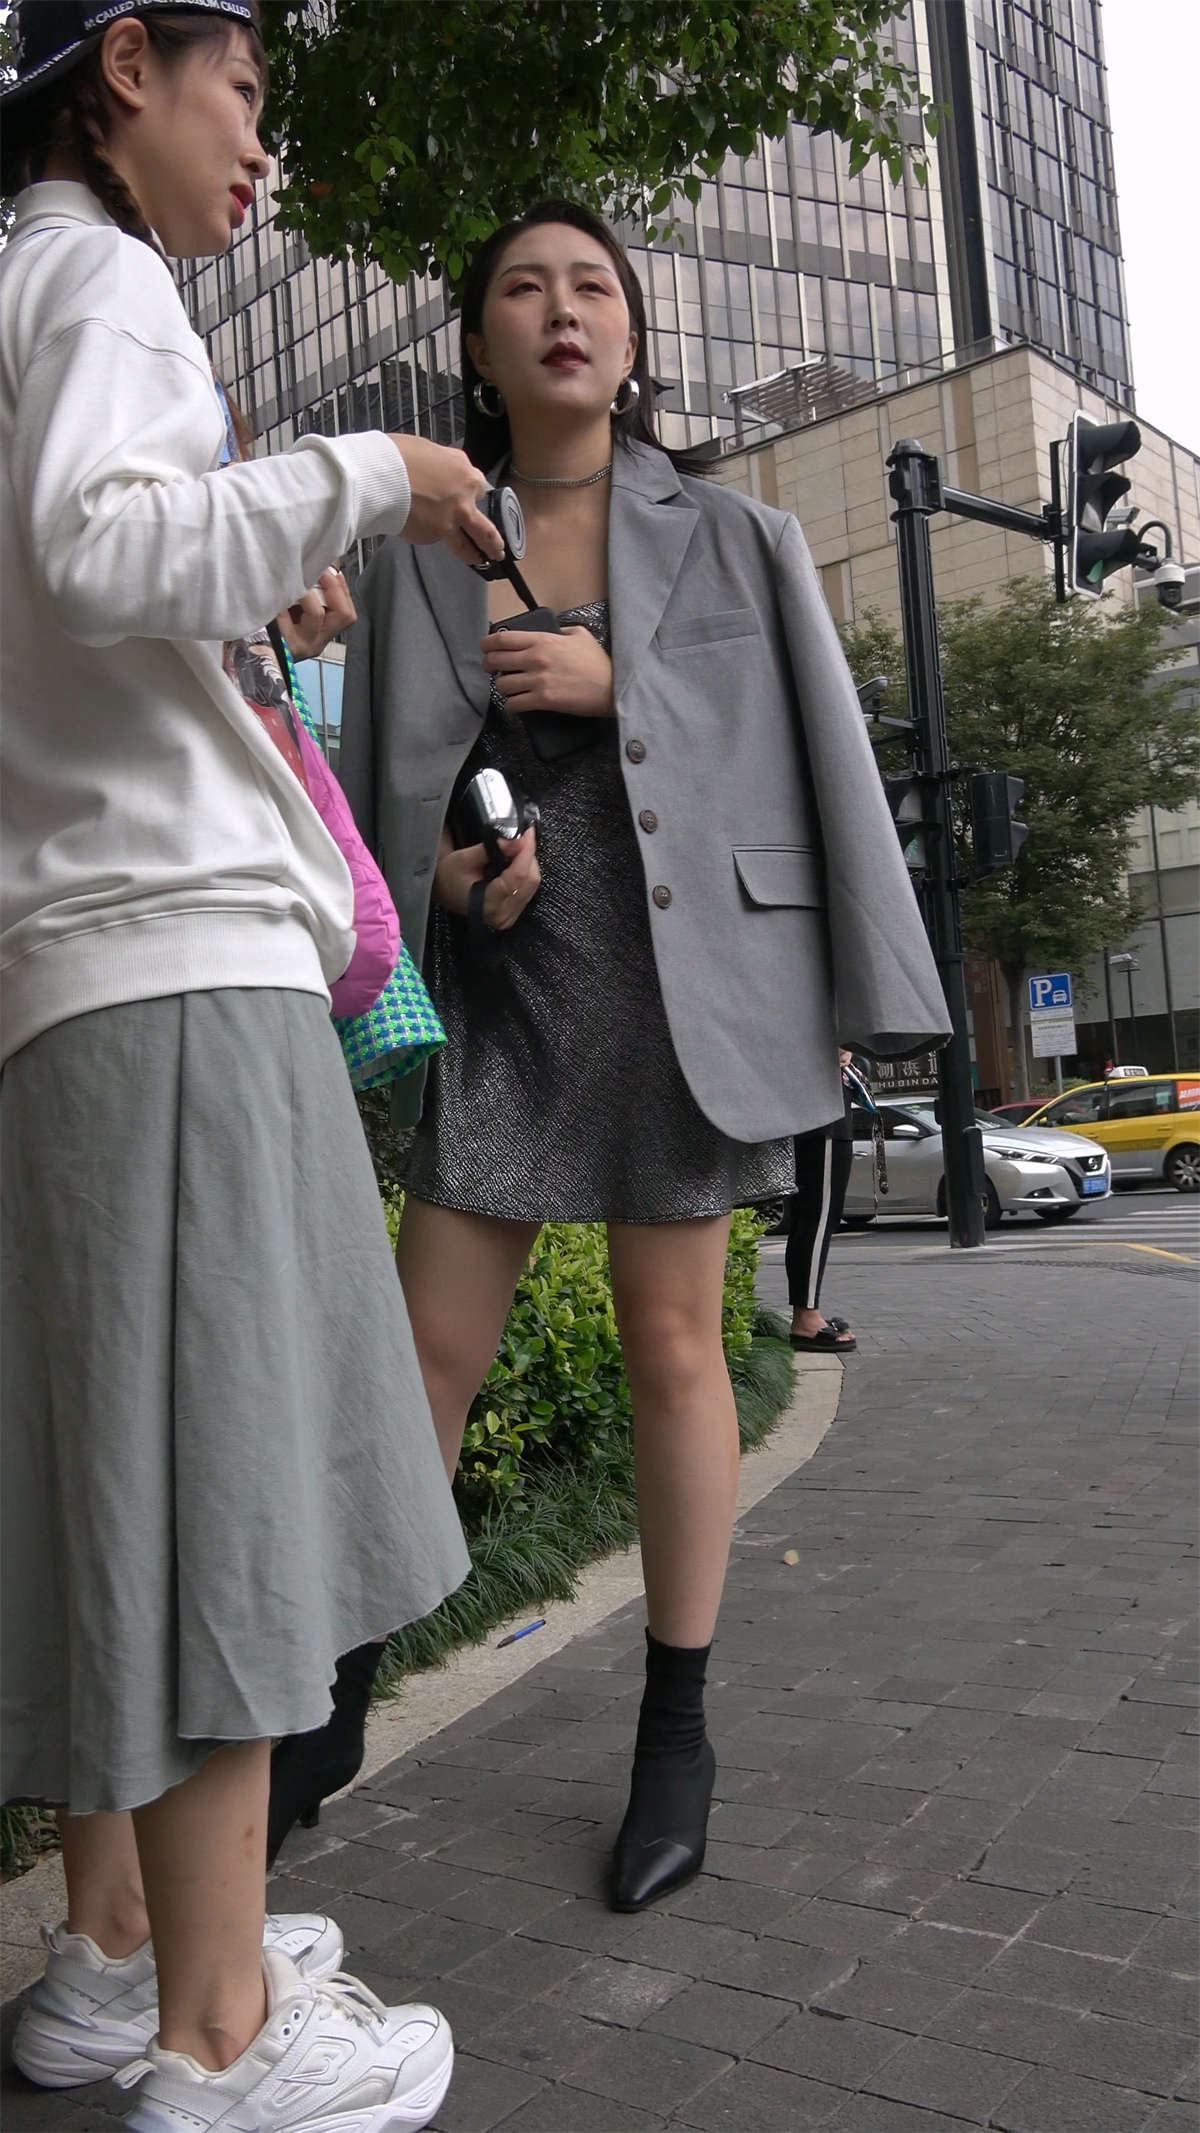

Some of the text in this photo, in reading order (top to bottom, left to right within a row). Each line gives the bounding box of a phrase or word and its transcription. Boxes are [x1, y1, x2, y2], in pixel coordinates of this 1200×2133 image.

[95, 1, 135, 24] CALLED
[220, 1, 251, 18] CALLED
[1032, 979, 1052, 1007] P
[879, 1077, 938, 1088] HUBINDA
